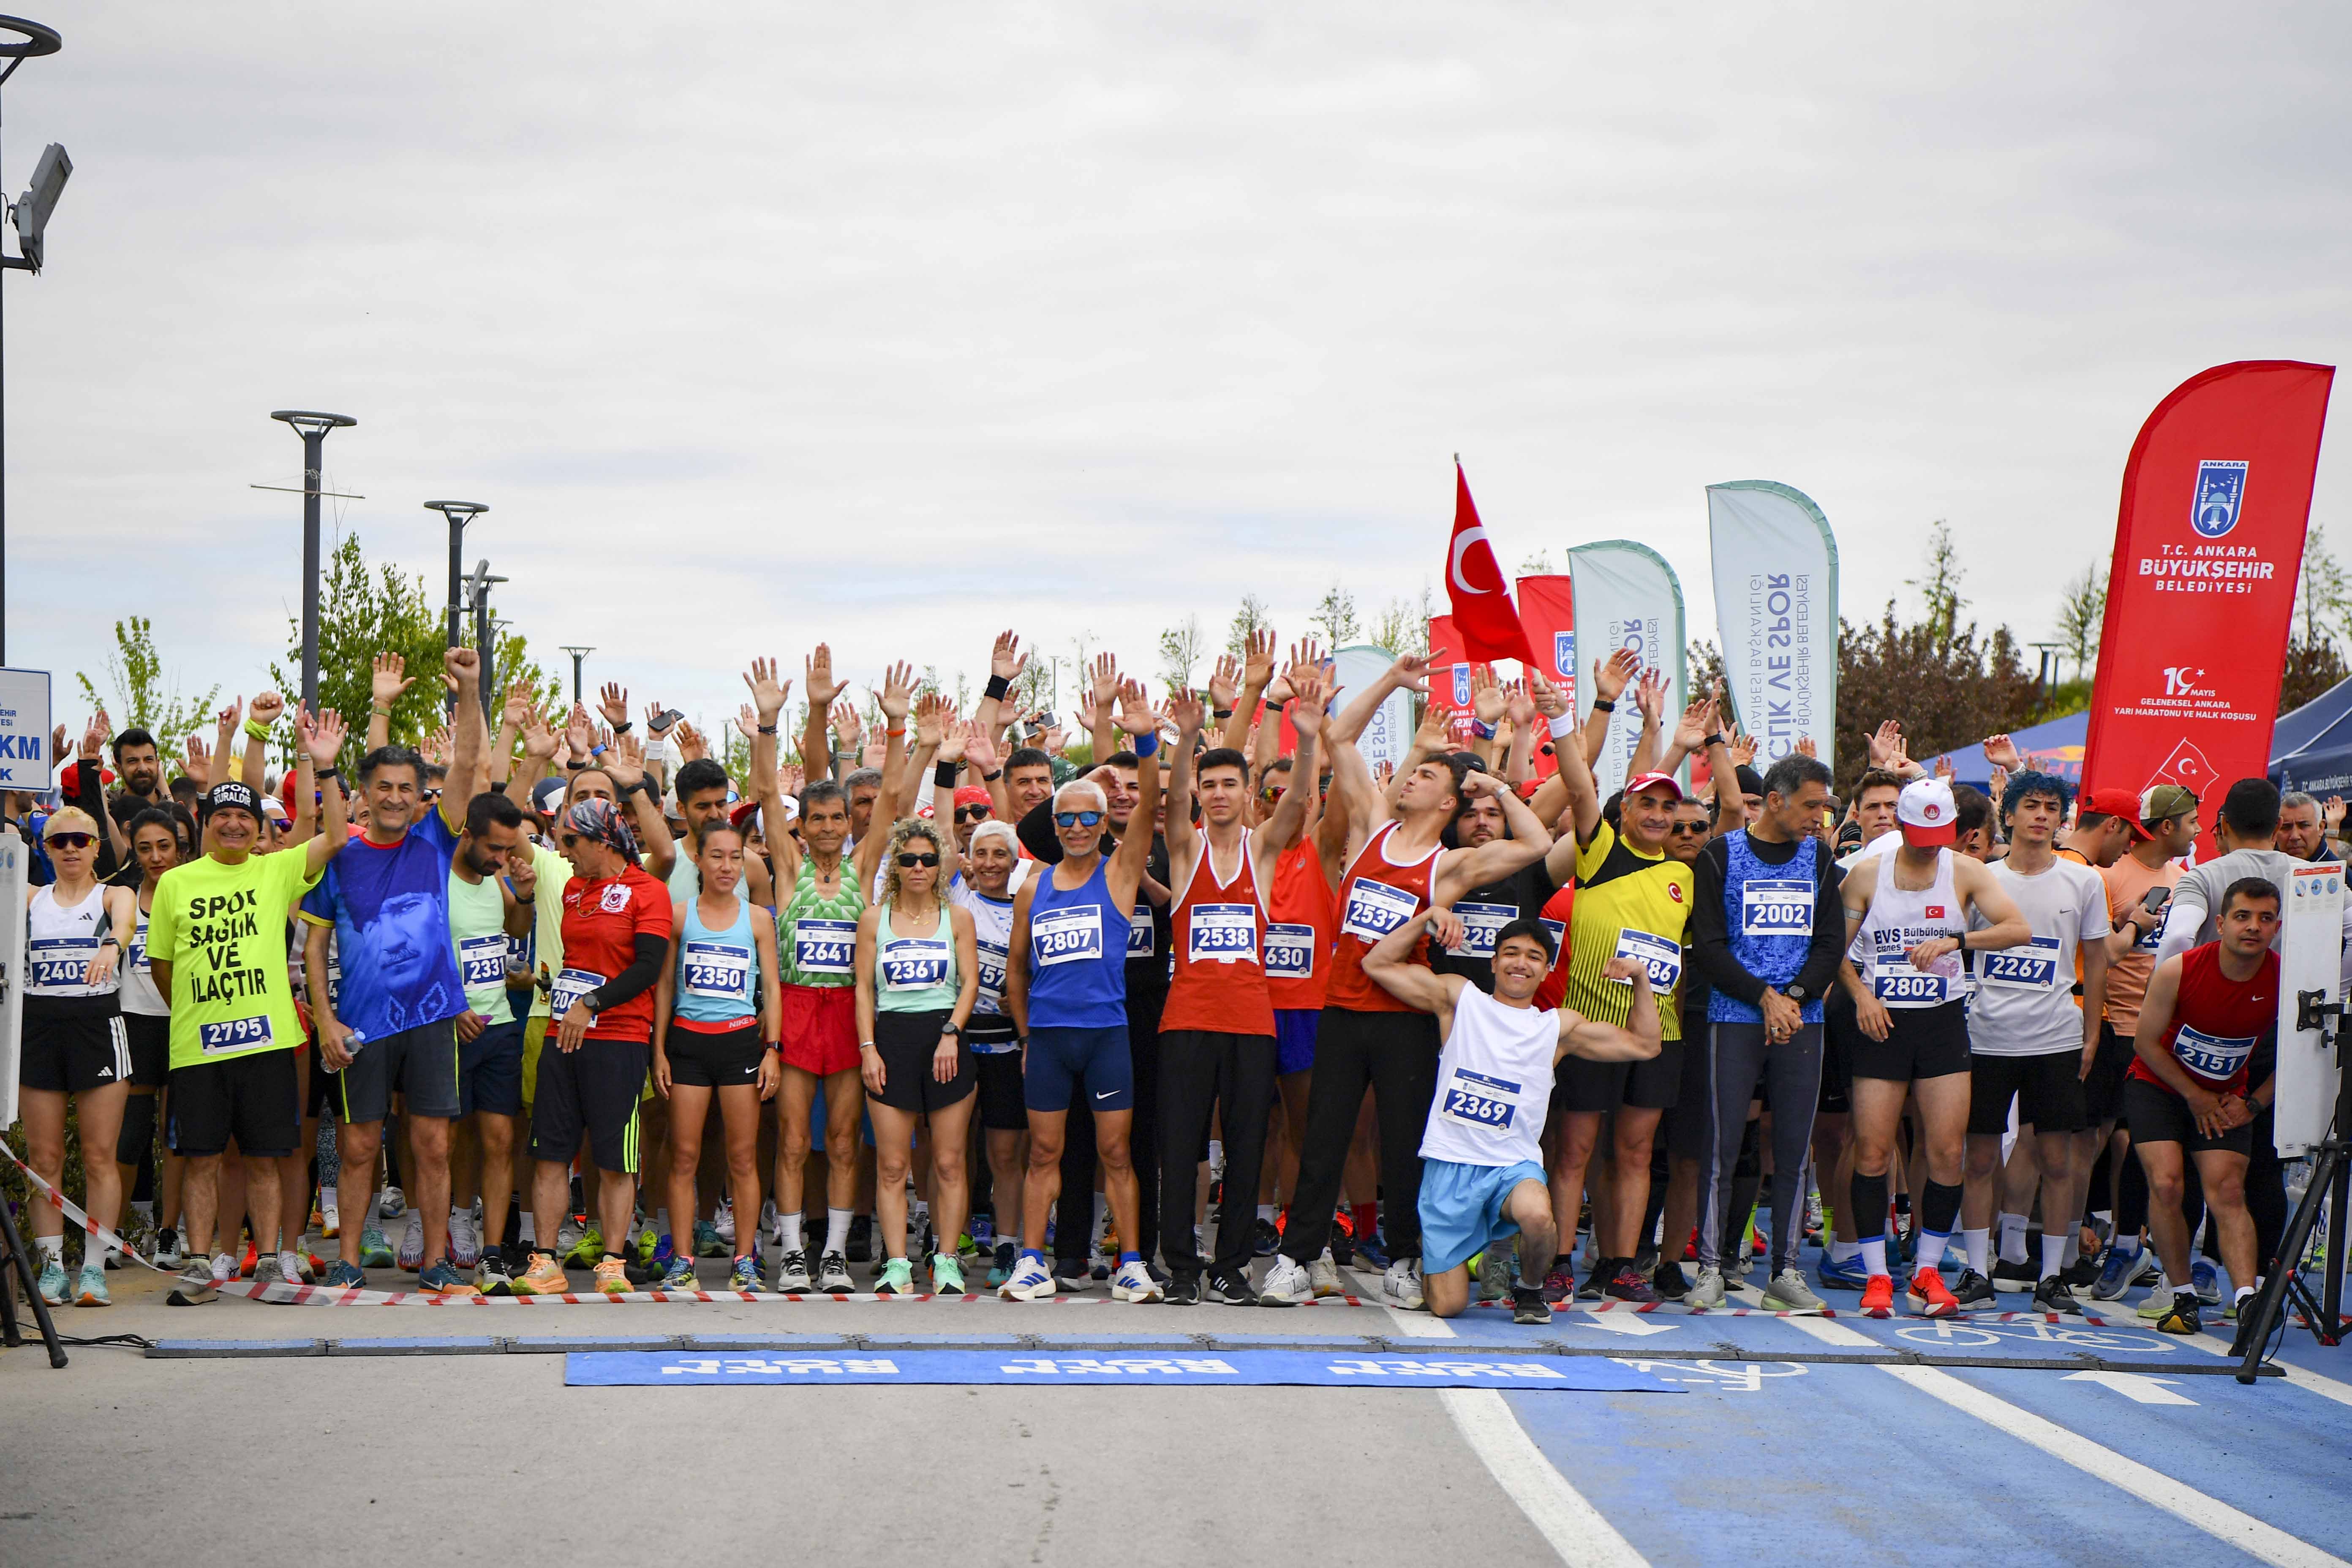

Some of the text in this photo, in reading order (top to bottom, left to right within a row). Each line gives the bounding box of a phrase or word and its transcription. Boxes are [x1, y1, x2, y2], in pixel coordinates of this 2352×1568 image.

[2162, 544, 2257, 558] T.C. ANKARA
[2139, 558, 2274, 579] BÜYÜKŞEHİR
[2156, 580, 2252, 593] BELEDİYESİ
[2141, 698, 2192, 707] GELENEKSEL
[2135, 708, 2181, 717] MARATONU
[2221, 712, 2257, 721] KOŞUSU
[213, 784, 250, 796] SPOR
[214, 792, 251, 807] KURALDIR
[1351, 902, 1402, 930] 2537
[1754, 904, 1805, 923] 2002
[190, 912, 259, 948] SAĞLIK
[1198, 928, 1249, 947] 2538
[1042, 929, 1092, 954] 2807
[207, 942, 242, 971] VE
[803, 942, 851, 962] 2641
[1265, 947, 1303, 966] 630
[470, 957, 504, 980] 2331
[691, 966, 740, 988] 2350
[890, 961, 938, 980] 2361
[1992, 956, 2047, 978] 2267
[191, 968, 267, 1005] İLAÇTIR
[1883, 977, 1939, 996] 2802
[208, 1018, 262, 1043] 2795
[729, 1017, 749, 1029] NIKE
[2182, 1048, 2237, 1071] 2151
[1452, 1092, 1507, 1121] 2369
